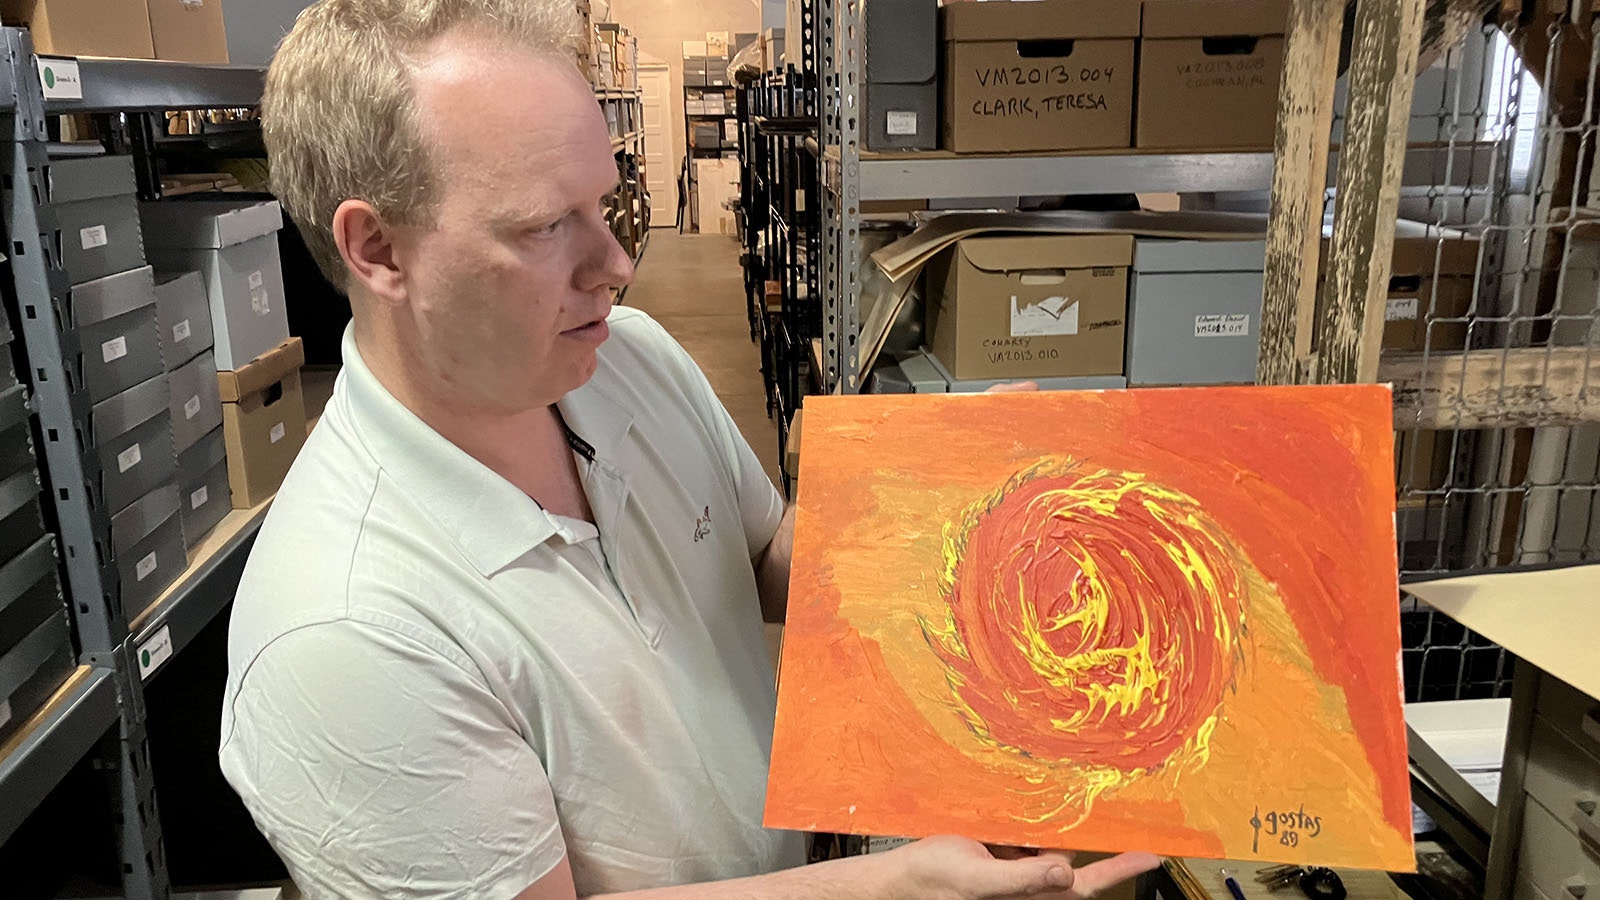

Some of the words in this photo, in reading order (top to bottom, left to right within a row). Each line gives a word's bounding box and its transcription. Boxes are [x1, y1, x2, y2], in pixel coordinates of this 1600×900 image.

[972, 97, 1038, 120] CLARK,
[1041, 94, 1107, 112] TERESA
[1279, 830, 1299, 848] 89
